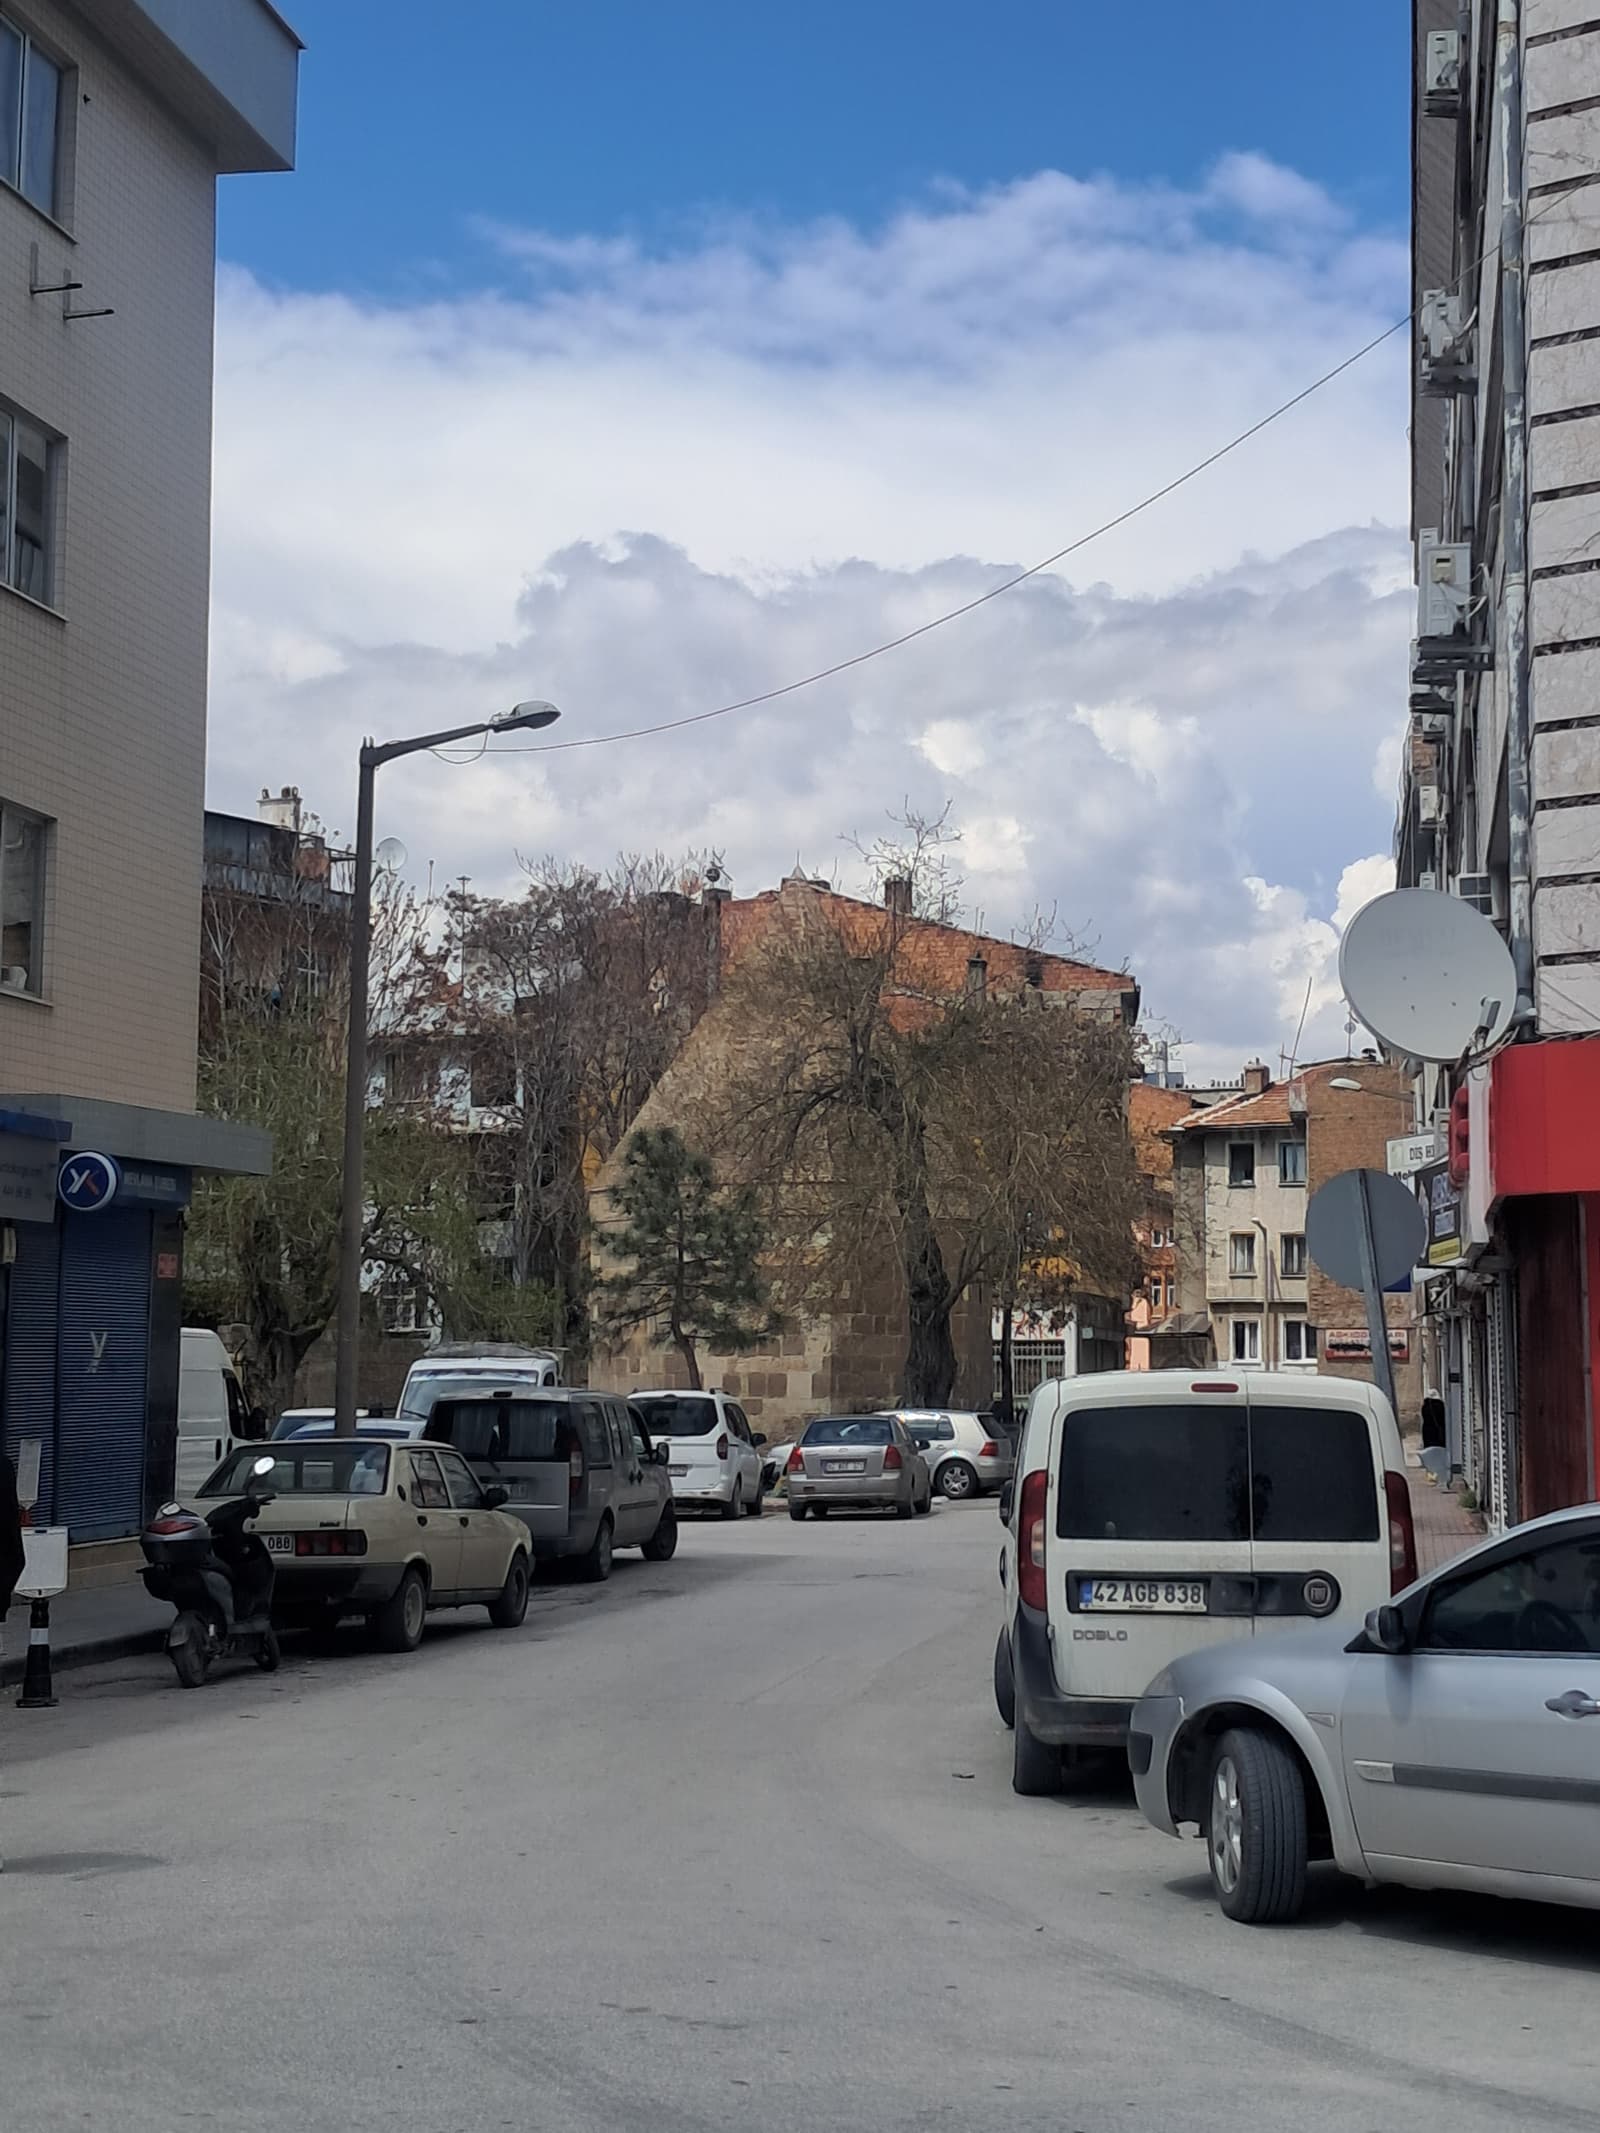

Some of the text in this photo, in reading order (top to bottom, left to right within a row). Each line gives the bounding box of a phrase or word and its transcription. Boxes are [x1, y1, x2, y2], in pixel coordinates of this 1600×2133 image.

[268, 1536, 290, 1550] 088
[1093, 1583, 1201, 1604] 42 AGB 838
[1073, 1629, 1128, 1641] DOBLO
